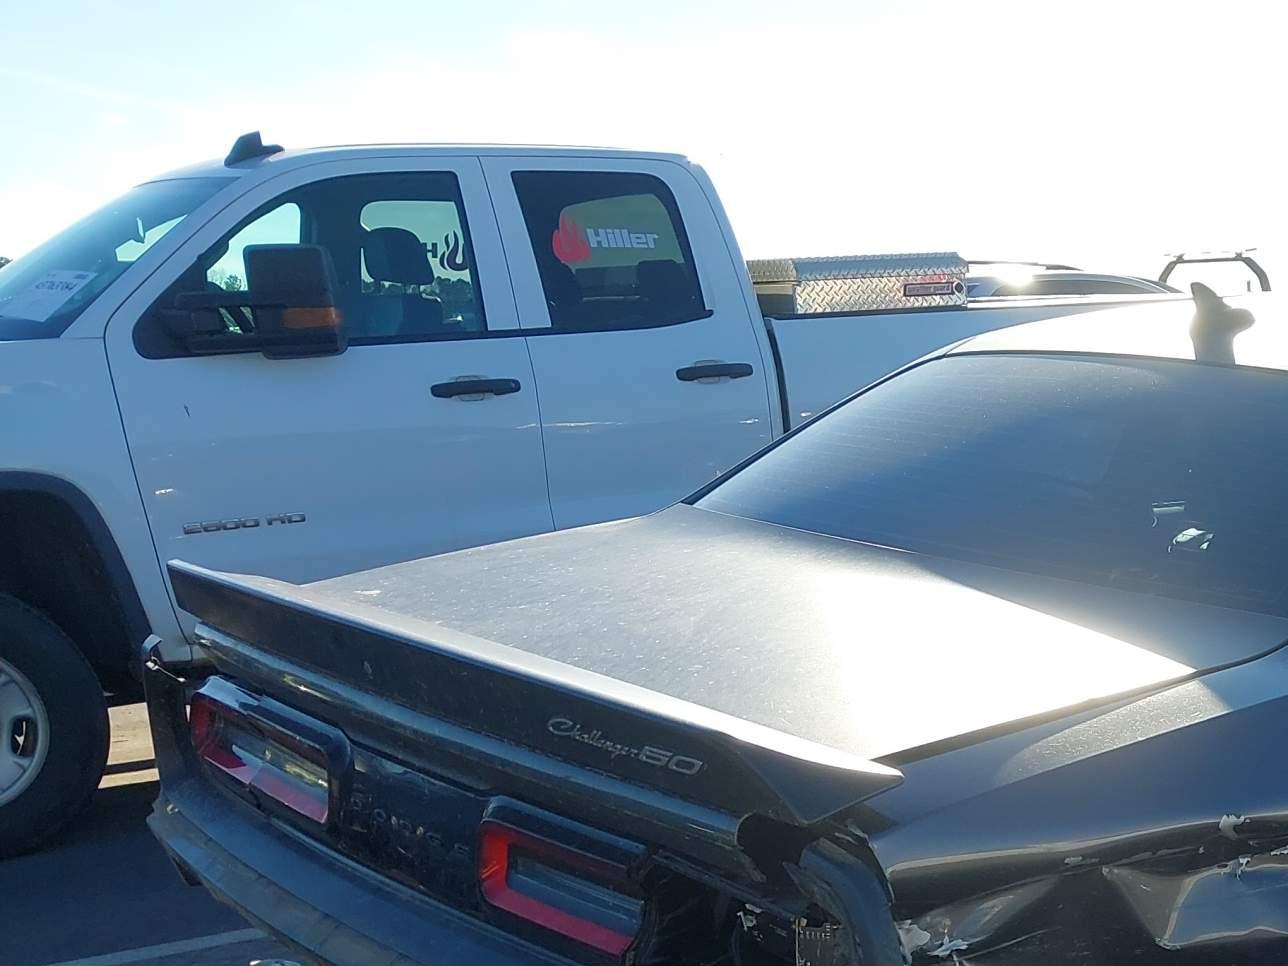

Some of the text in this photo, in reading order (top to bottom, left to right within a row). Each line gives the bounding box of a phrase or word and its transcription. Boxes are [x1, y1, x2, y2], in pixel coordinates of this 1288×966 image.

[586, 228, 660, 249] Hiller
[266, 511, 306, 526] HD
[547, 718, 639, 759] Challenger
